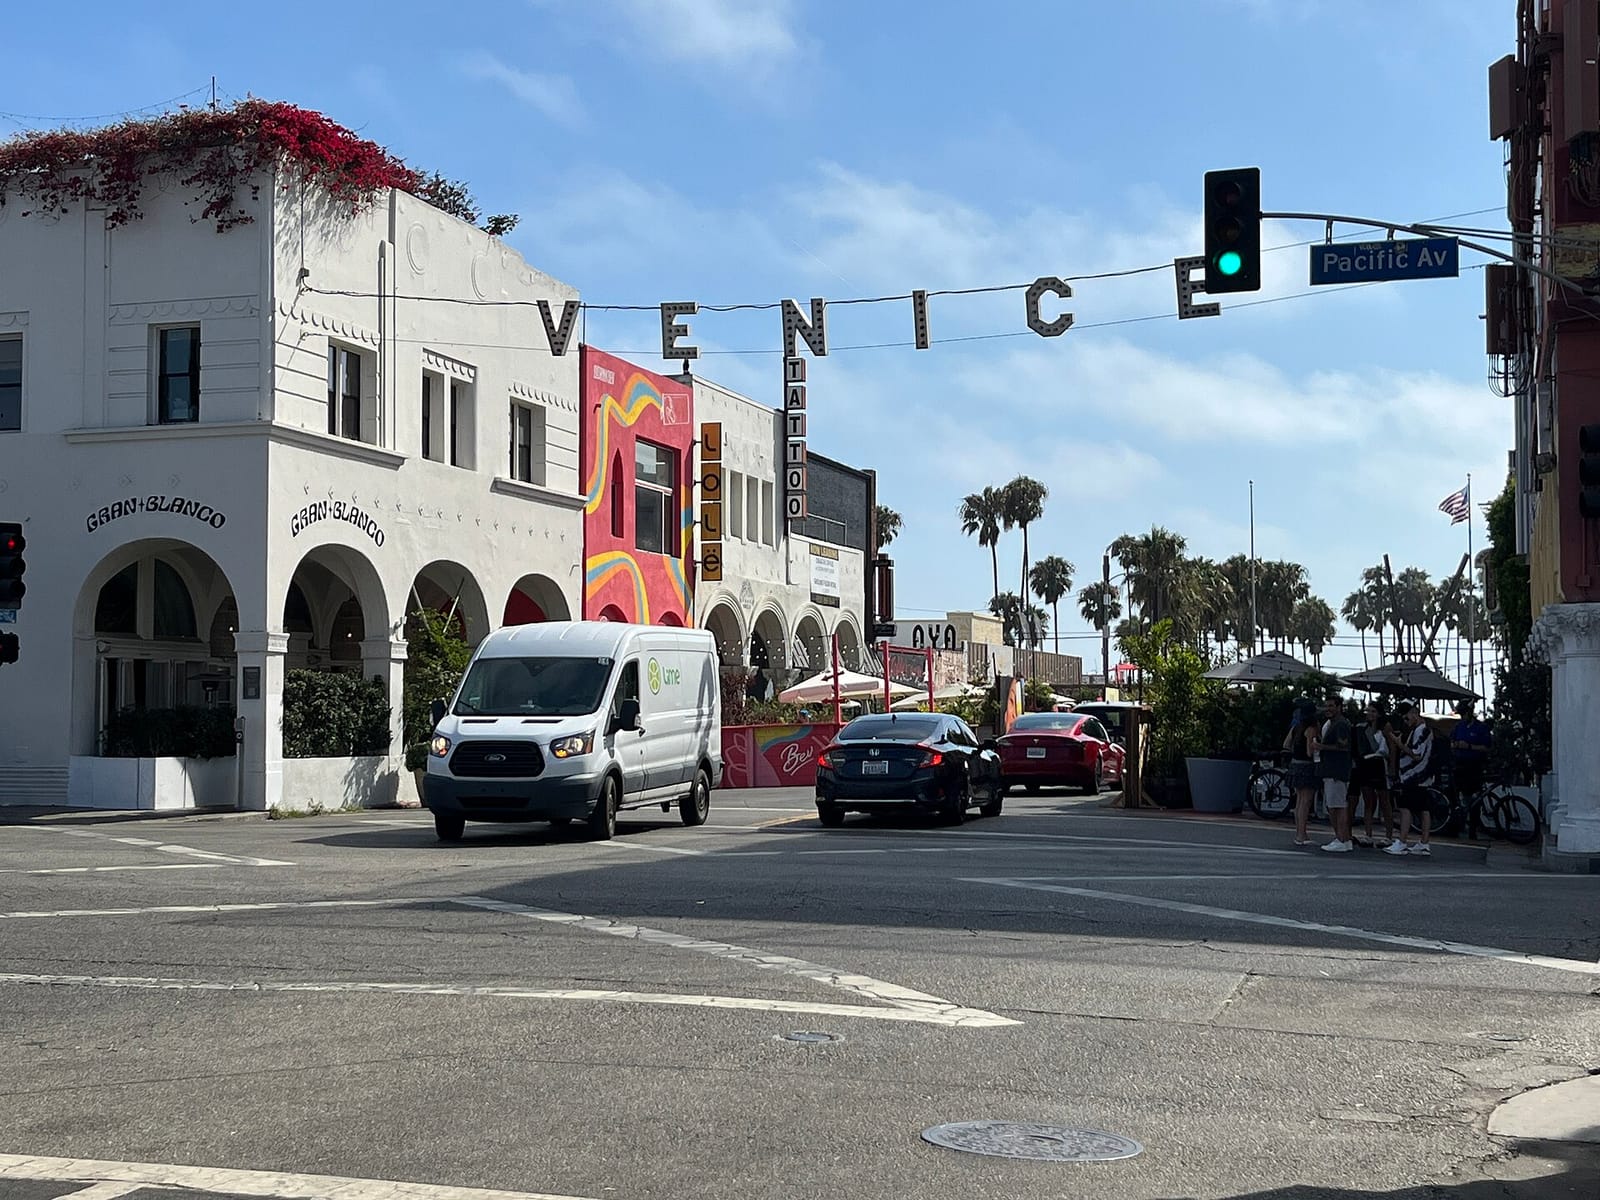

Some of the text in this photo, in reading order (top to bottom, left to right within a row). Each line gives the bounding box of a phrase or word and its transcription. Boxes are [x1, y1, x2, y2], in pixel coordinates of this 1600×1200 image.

[1323, 247, 1448, 273] Pacific Av
[537, 257, 1221, 359] VENICE
[786, 360, 803, 516] TATTOO
[86, 495, 227, 533] GRAN BLANCO
[290, 500, 385, 548] GRAN BLANCO
[912, 624, 957, 651] AYA
